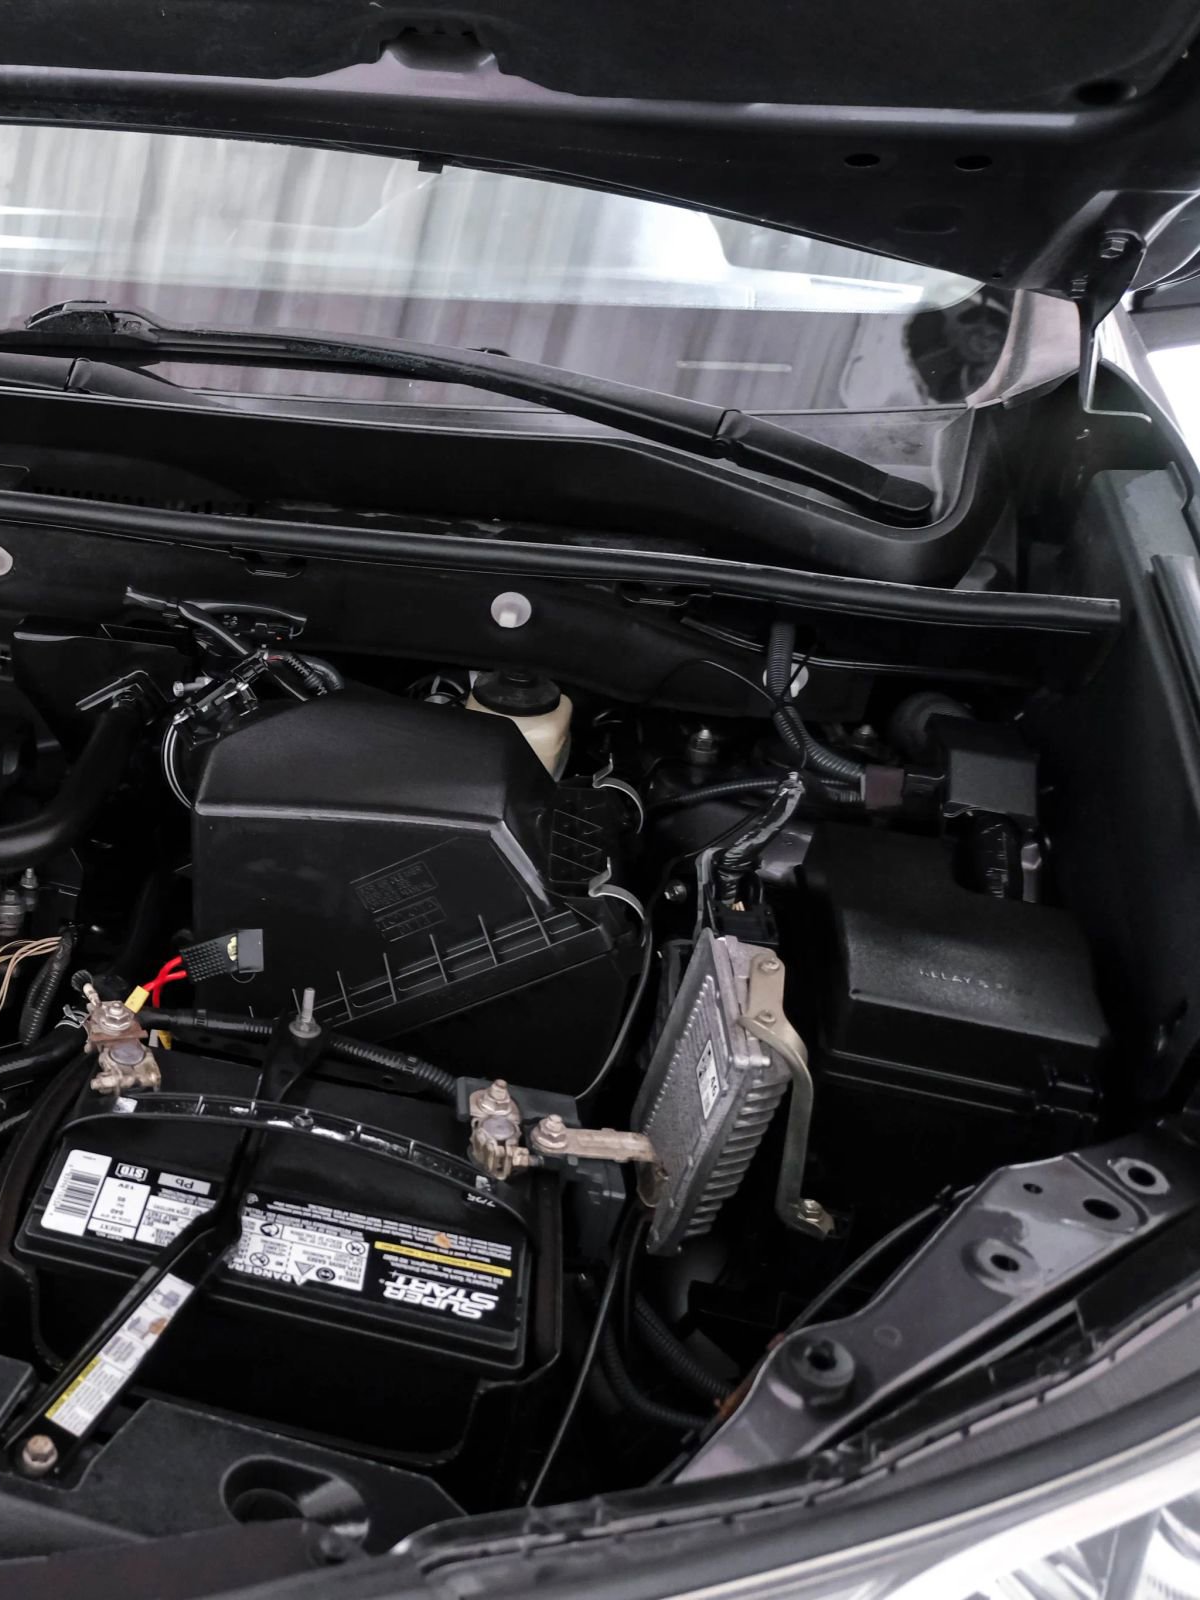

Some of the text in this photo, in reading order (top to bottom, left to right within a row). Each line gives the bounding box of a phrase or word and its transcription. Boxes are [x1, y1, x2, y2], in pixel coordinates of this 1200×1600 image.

[120, 1165, 144, 1179] STD
[176, 1178, 194, 1189] Pb
[383, 1287, 482, 1319] SUPER
[384, 1275, 499, 1310] START
